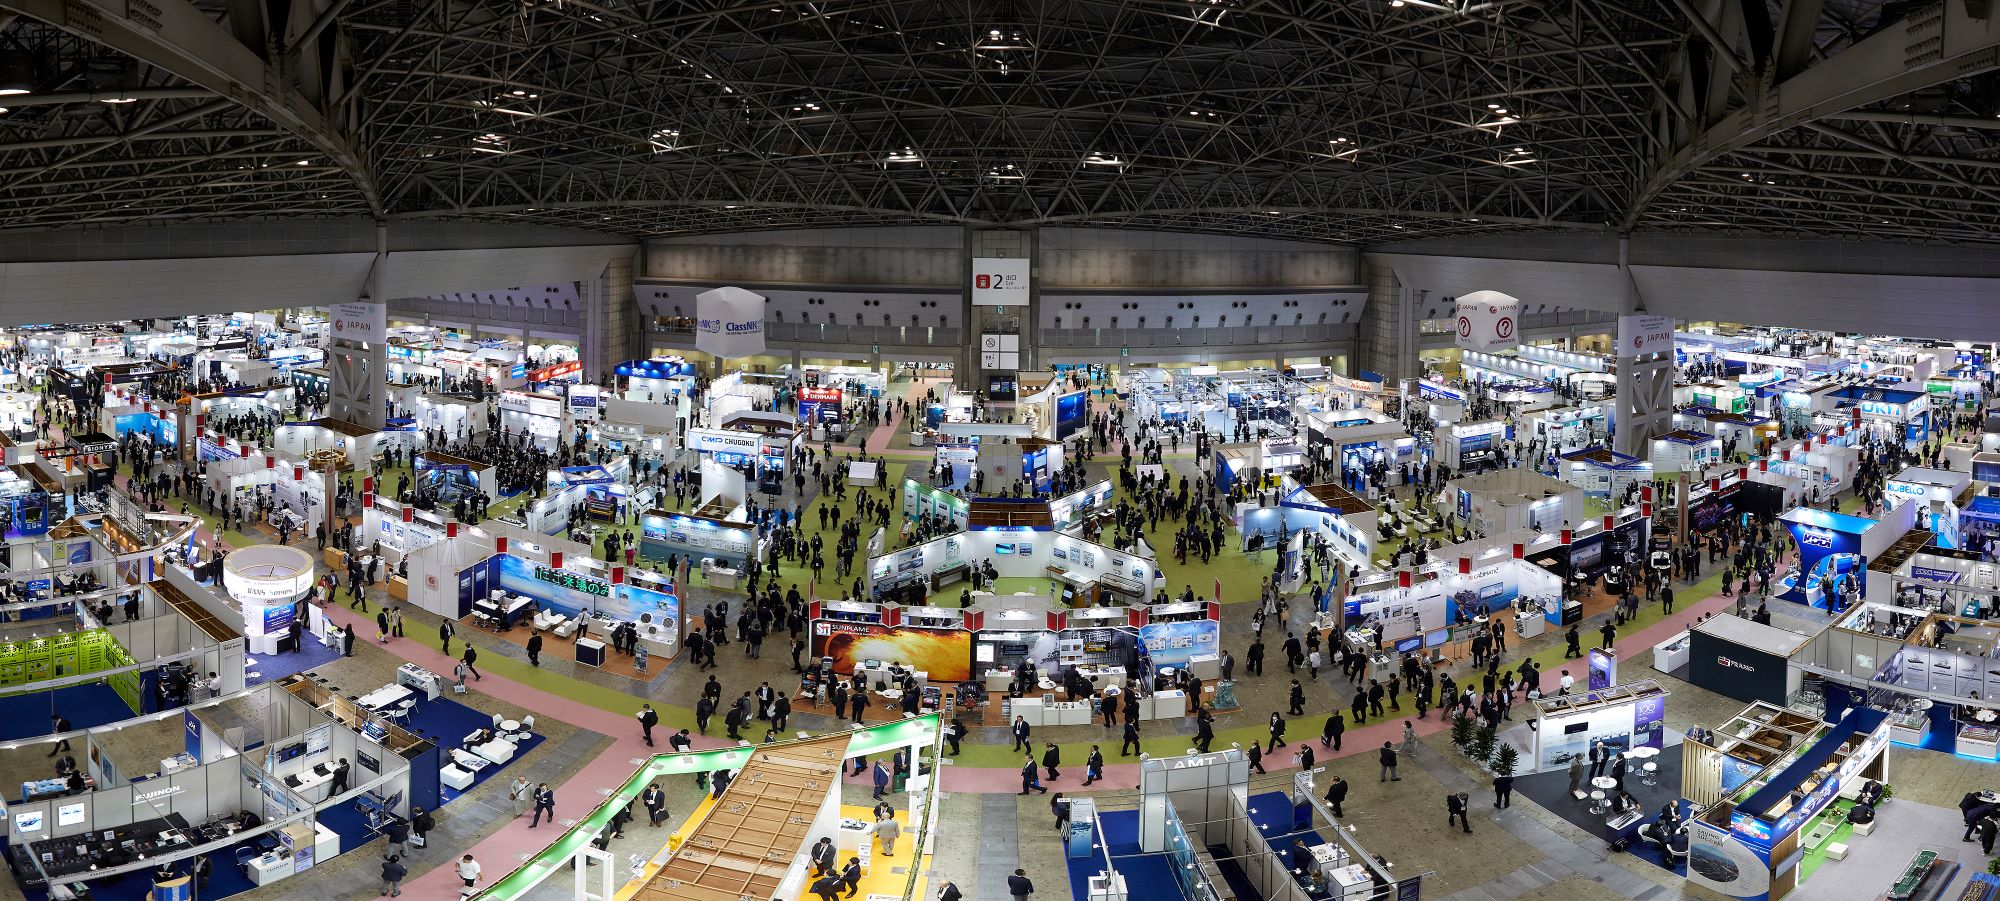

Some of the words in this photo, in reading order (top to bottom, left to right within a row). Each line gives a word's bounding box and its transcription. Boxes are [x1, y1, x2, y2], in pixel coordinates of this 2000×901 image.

[993, 274, 1004, 290] 2
[347, 321, 371, 331] JAPAN
[726, 320, 758, 332] ClassNK
[1647, 332, 1670, 342] JAPAN
[724, 438, 755, 447] CHUGOKU
[1887, 483, 1925, 496] KOBELCO
[1803, 534, 1832, 548] KDDI
[1473, 566, 1499, 580] CADMATIC
[832, 623, 870, 634] SUNFLAME
[1173, 756, 1217, 769] AMT
[135, 785, 181, 802] FUJINON
